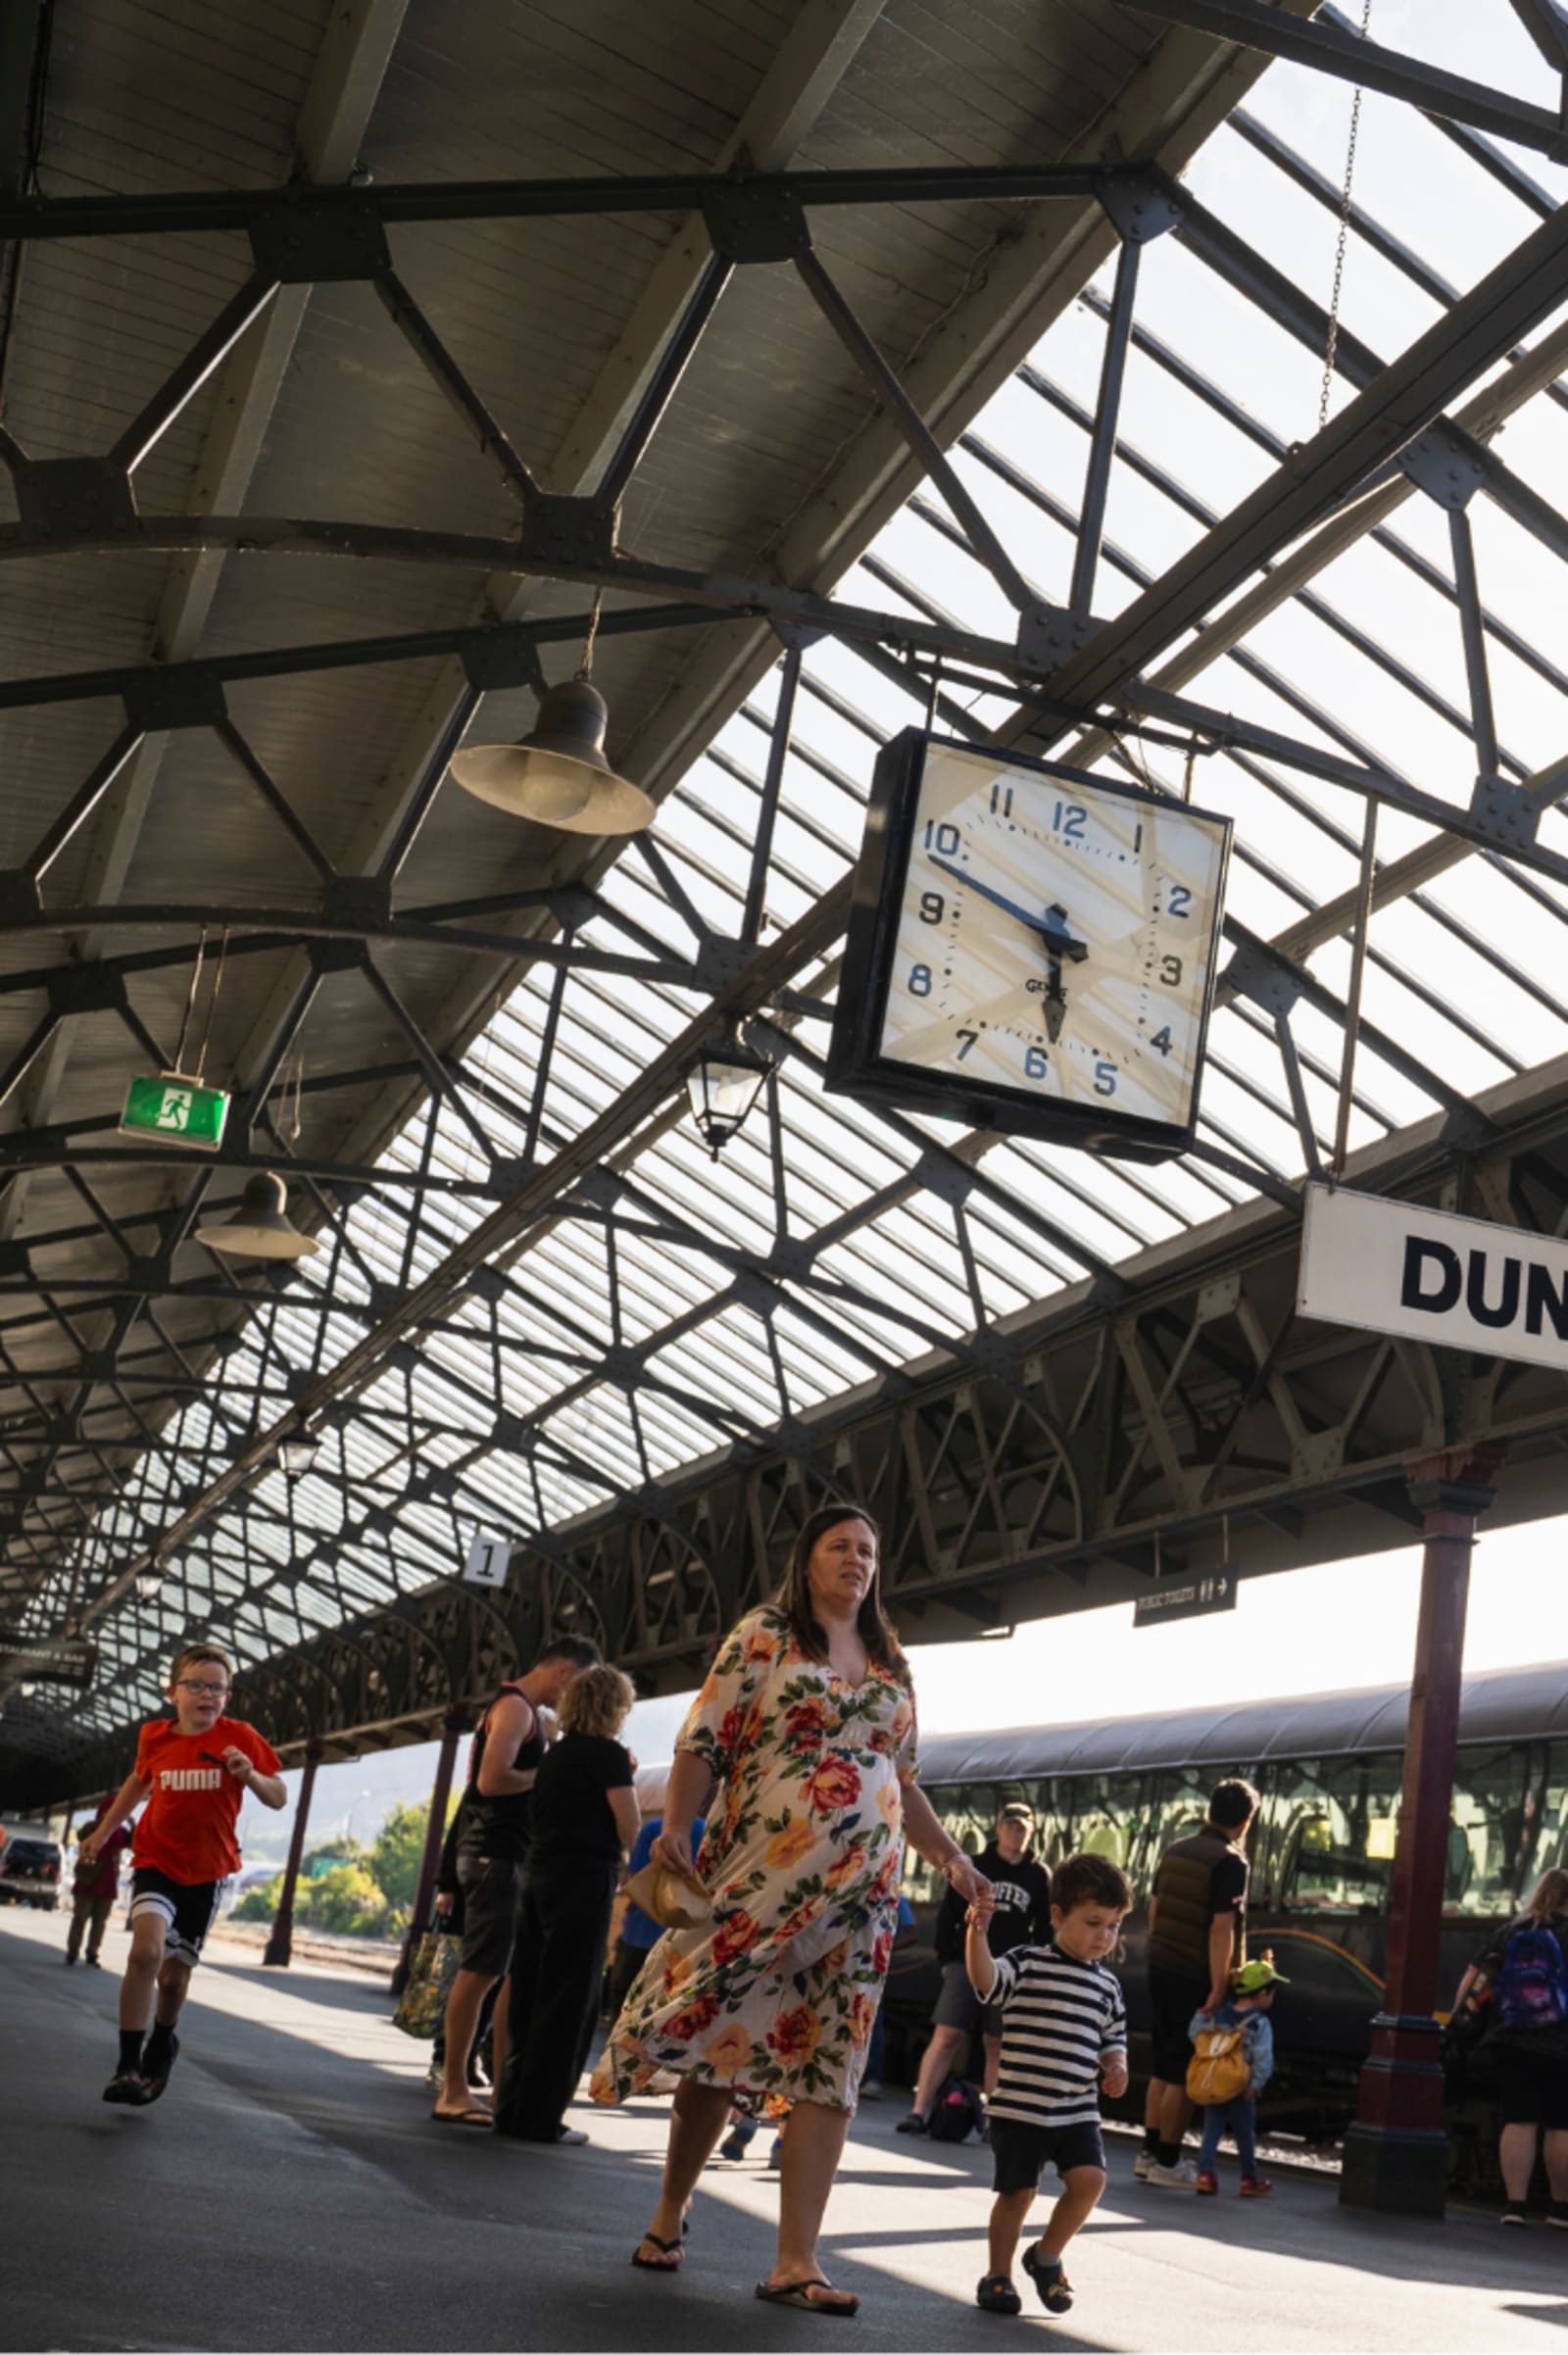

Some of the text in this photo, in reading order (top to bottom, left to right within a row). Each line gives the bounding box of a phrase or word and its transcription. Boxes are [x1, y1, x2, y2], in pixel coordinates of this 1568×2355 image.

[990, 784, 1013, 817] 11
[1053, 801, 1088, 838] 12
[924, 819, 959, 857] 10
[1134, 823, 1143, 854] 1
[919, 892, 944, 925] 9
[1167, 885, 1191, 918] 2
[907, 963, 932, 997] 8
[1159, 956, 1182, 987] 3
[956, 1029, 979, 1060] 7
[1150, 1026, 1173, 1056] 4
[1024, 1046, 1048, 1079] 6
[1094, 1061, 1118, 1096] 5
[1401, 1235, 1568, 1341] DUN
[476, 1544, 494, 1578] 1
[63, 1653, 86, 1664] BAR
[160, 1769, 221, 1791] PUMA
